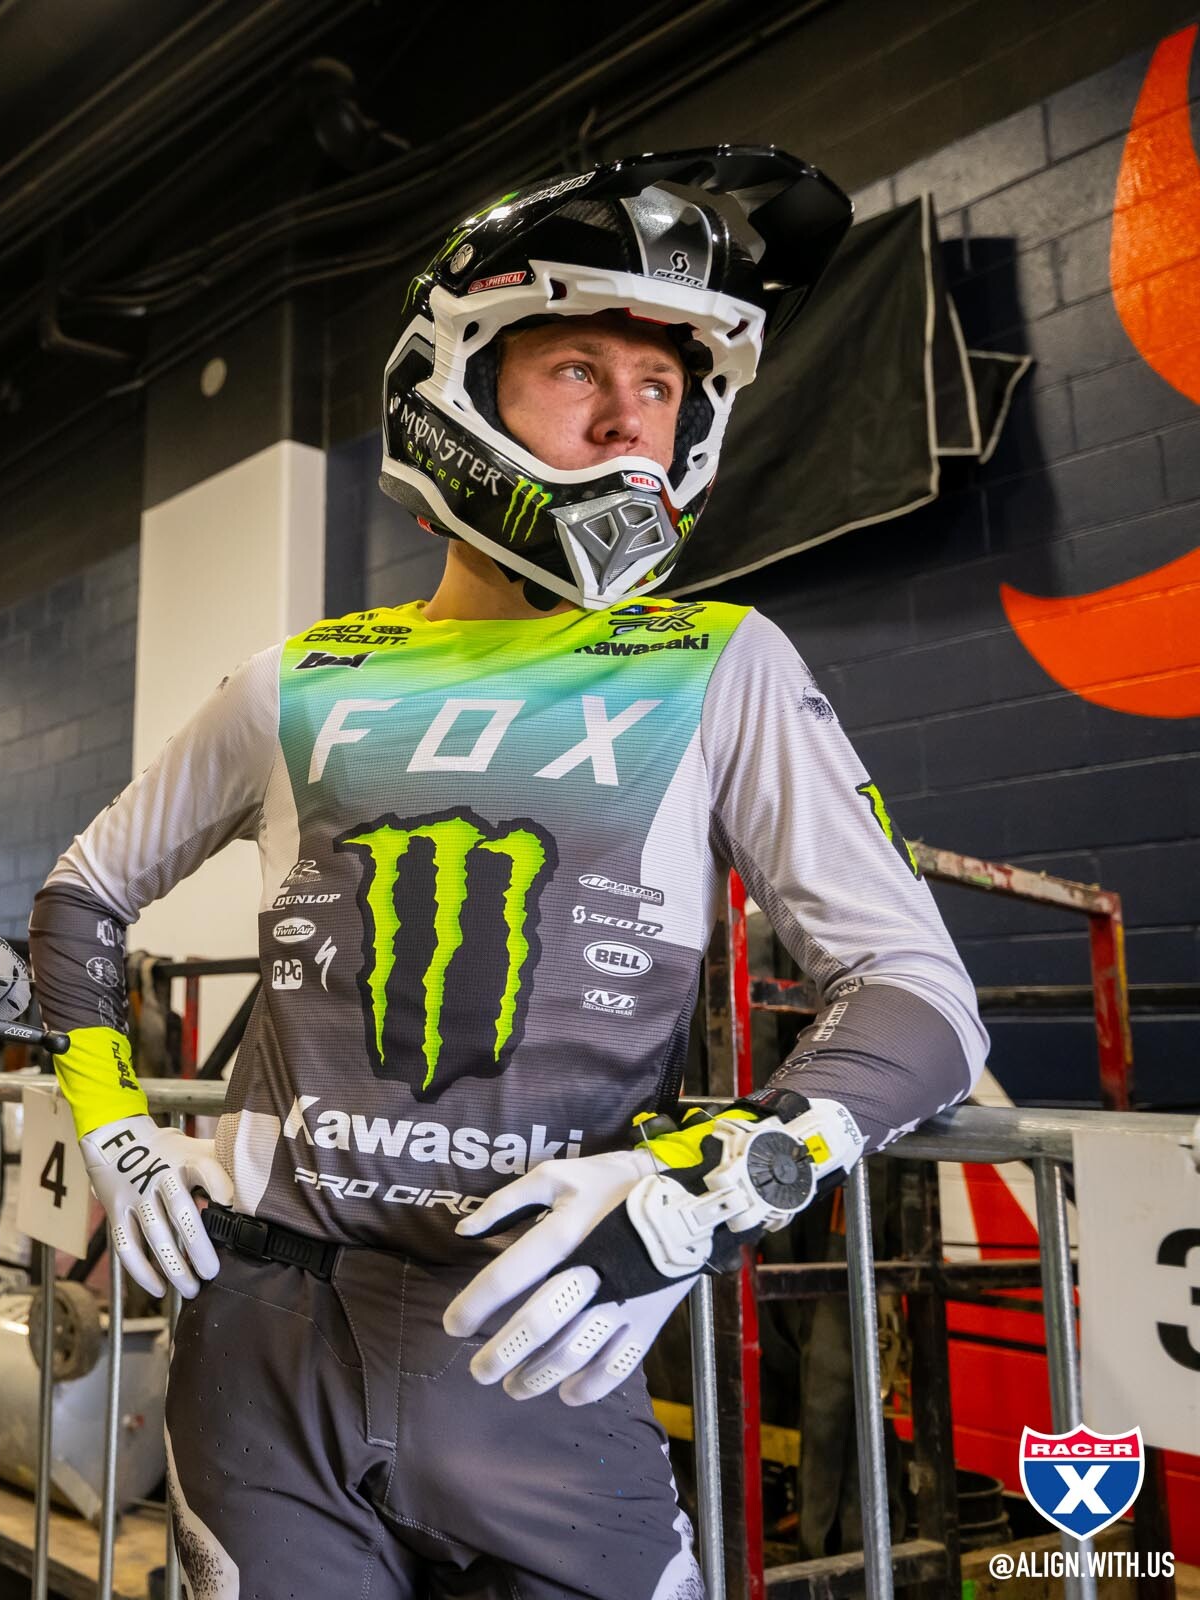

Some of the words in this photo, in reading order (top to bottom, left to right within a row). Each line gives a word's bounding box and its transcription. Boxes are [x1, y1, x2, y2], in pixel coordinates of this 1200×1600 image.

[484, 272, 522, 288] SPHERICAL
[655, 270, 704, 288] SCOTT
[407, 441, 475, 498] ENERGY
[631, 476, 657, 488] BELL
[309, 625, 365, 633] PRO
[308, 696, 663, 786] FOX
[275, 893, 341, 907] DUNLOP
[606, 881, 662, 899] MAXIMA
[588, 912, 662, 936] SCOTT
[595, 949, 640, 970] BELL
[4, 1027, 32, 1038] ARC
[283, 1095, 583, 1175] Kawasaki
[101, 1129, 171, 1195] FOX
[40, 1140, 67, 1208] 4
[294, 1167, 379, 1200] PRO
